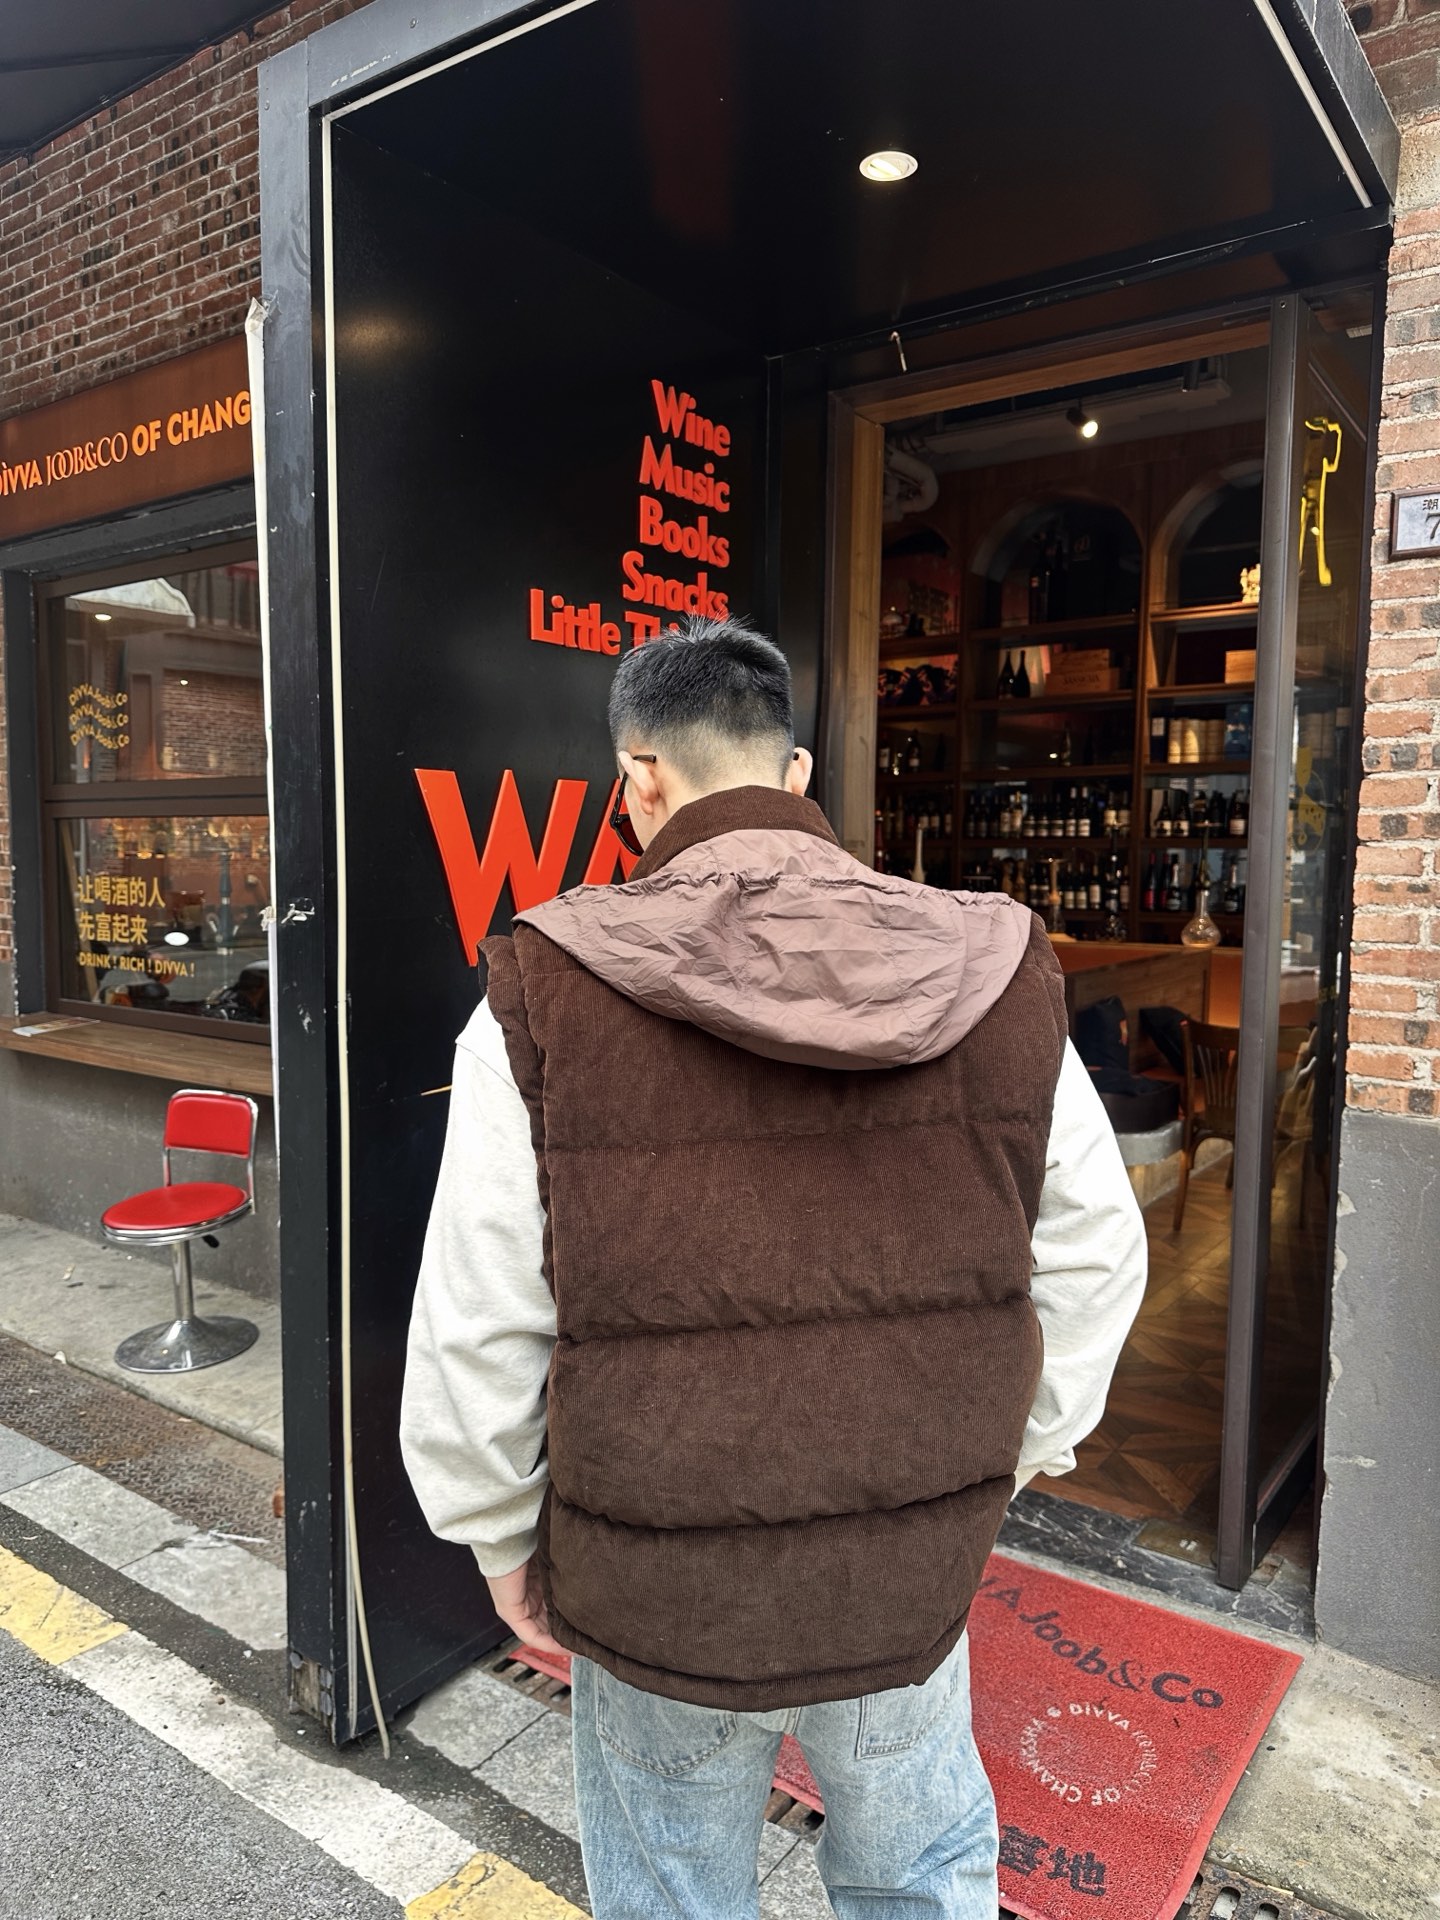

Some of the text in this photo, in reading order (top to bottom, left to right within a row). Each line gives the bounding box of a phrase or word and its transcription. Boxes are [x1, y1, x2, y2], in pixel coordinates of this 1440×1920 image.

[46, 431, 129, 486] JOOB&CO
[131, 419, 162, 456] OF
[166, 390, 251, 446] CHANG
[651, 379, 731, 456] Wine
[639, 435, 731, 513] Music
[640, 495, 730, 568] Books
[530, 588, 622, 656] Little
[622, 550, 729, 623] Snacks
[78, 875, 166, 908] 让喝酒的人
[79, 911, 148, 945] 先富起来
